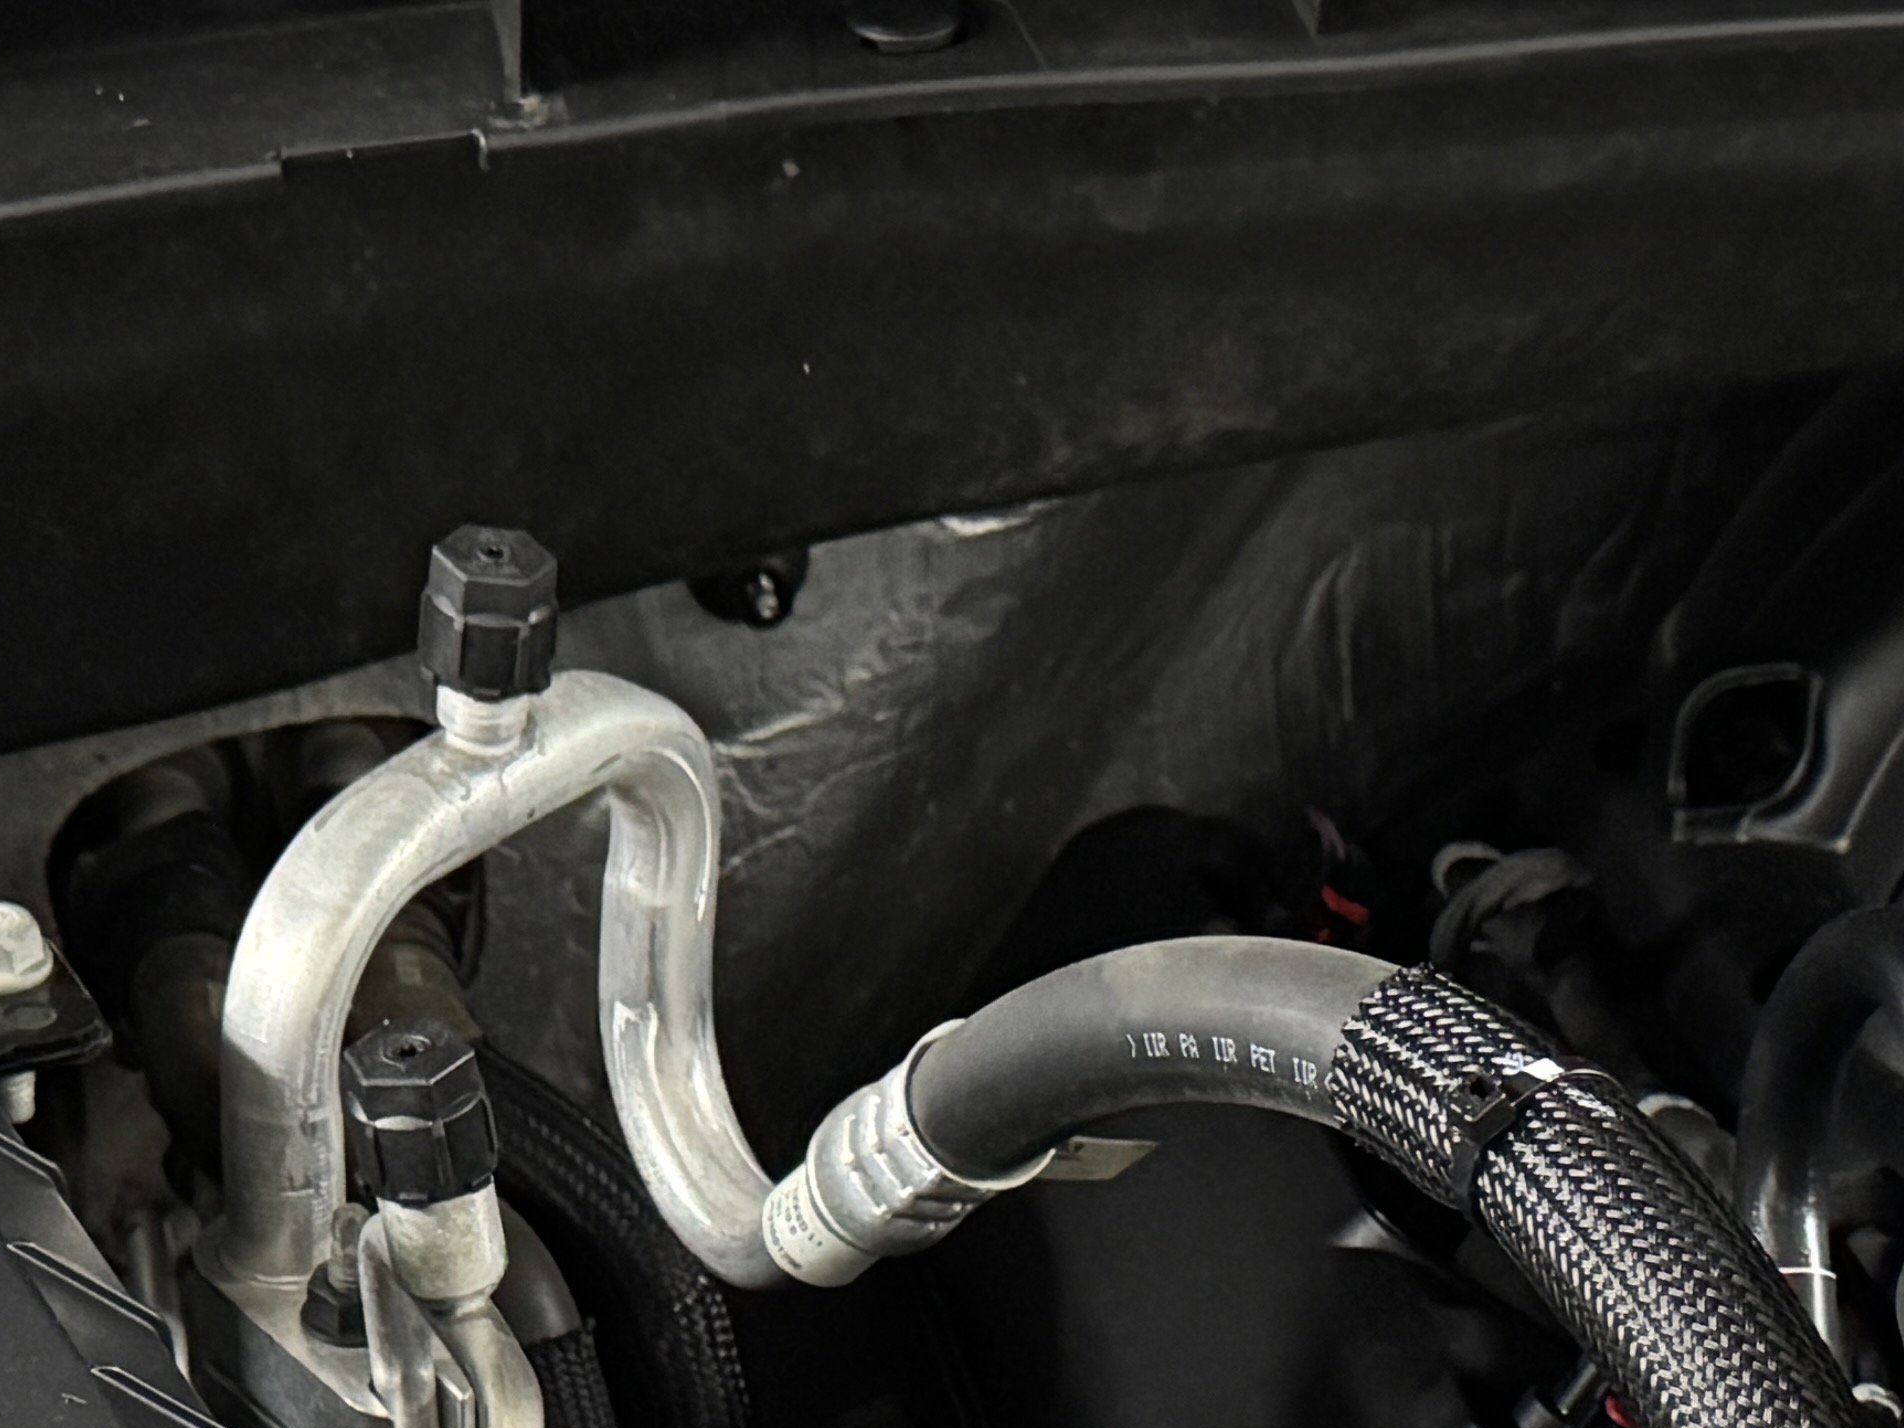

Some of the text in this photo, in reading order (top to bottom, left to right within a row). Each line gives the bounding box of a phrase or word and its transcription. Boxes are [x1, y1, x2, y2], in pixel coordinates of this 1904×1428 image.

[1179, 1033, 1199, 1058] PA
[1212, 1036, 1237, 1063] IIR
[1250, 1043, 1275, 1073] PET
